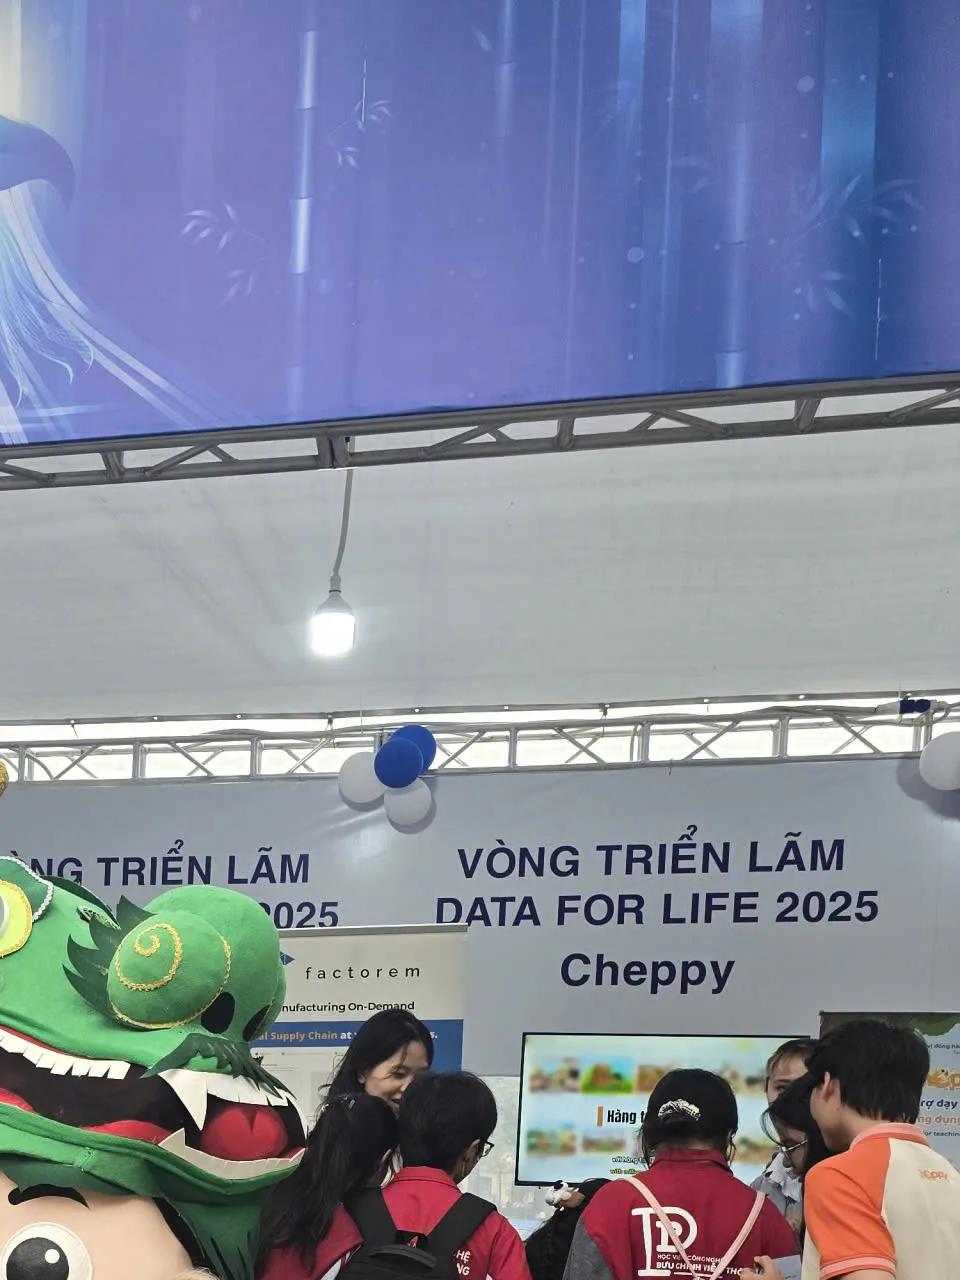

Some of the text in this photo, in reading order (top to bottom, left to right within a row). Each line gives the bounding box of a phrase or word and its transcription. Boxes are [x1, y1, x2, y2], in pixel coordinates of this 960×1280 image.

[457, 824, 844, 879] VÒNG TRIỂN LÃM
[97, 839, 212, 886] TRIỂN
[228, 847, 310, 884] LÃM
[436, 891, 878, 927] DATA FOR LIFE 2025
[306, 967, 420, 979] factorem
[561, 953, 735, 995] Cheppy
[283, 1002, 415, 1013] nufacturing On-Demand
[271, 1032, 305, 1043] Supply
[308, 1031, 338, 1040] Chain
[340, 1032, 352, 1040] at
[920, 1099, 958, 1110] rợ dạy
[607, 1109, 637, 1125] Hàng
